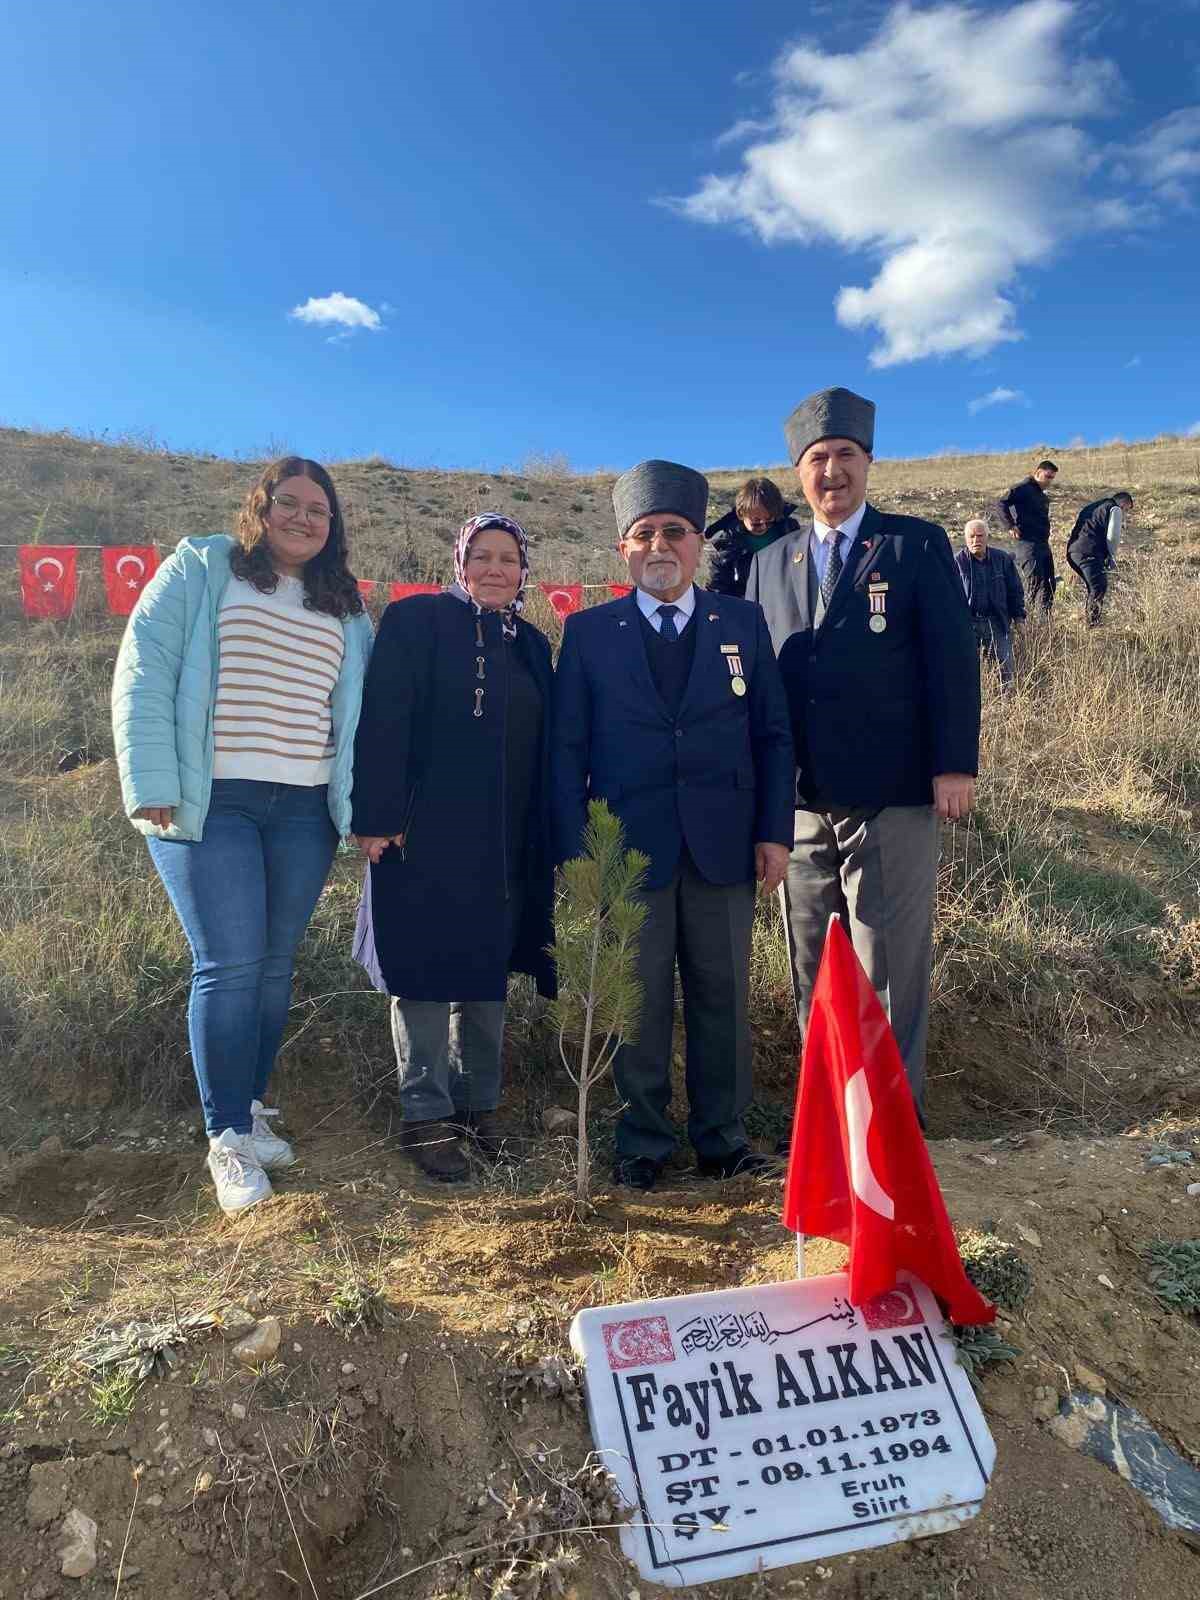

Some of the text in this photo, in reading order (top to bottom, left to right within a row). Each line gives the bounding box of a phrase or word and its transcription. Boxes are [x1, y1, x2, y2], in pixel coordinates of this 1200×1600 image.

[626, 1332, 937, 1440] Fayik ALKAN
[657, 1447, 719, 1473] DT
[752, 1409, 942, 1456] 01.01.1973
[665, 1475, 720, 1505] ŞT
[761, 1435, 952, 1485] 09.11.1994
[841, 1474, 906, 1498] Eruh
[852, 1494, 910, 1518] Siirt
